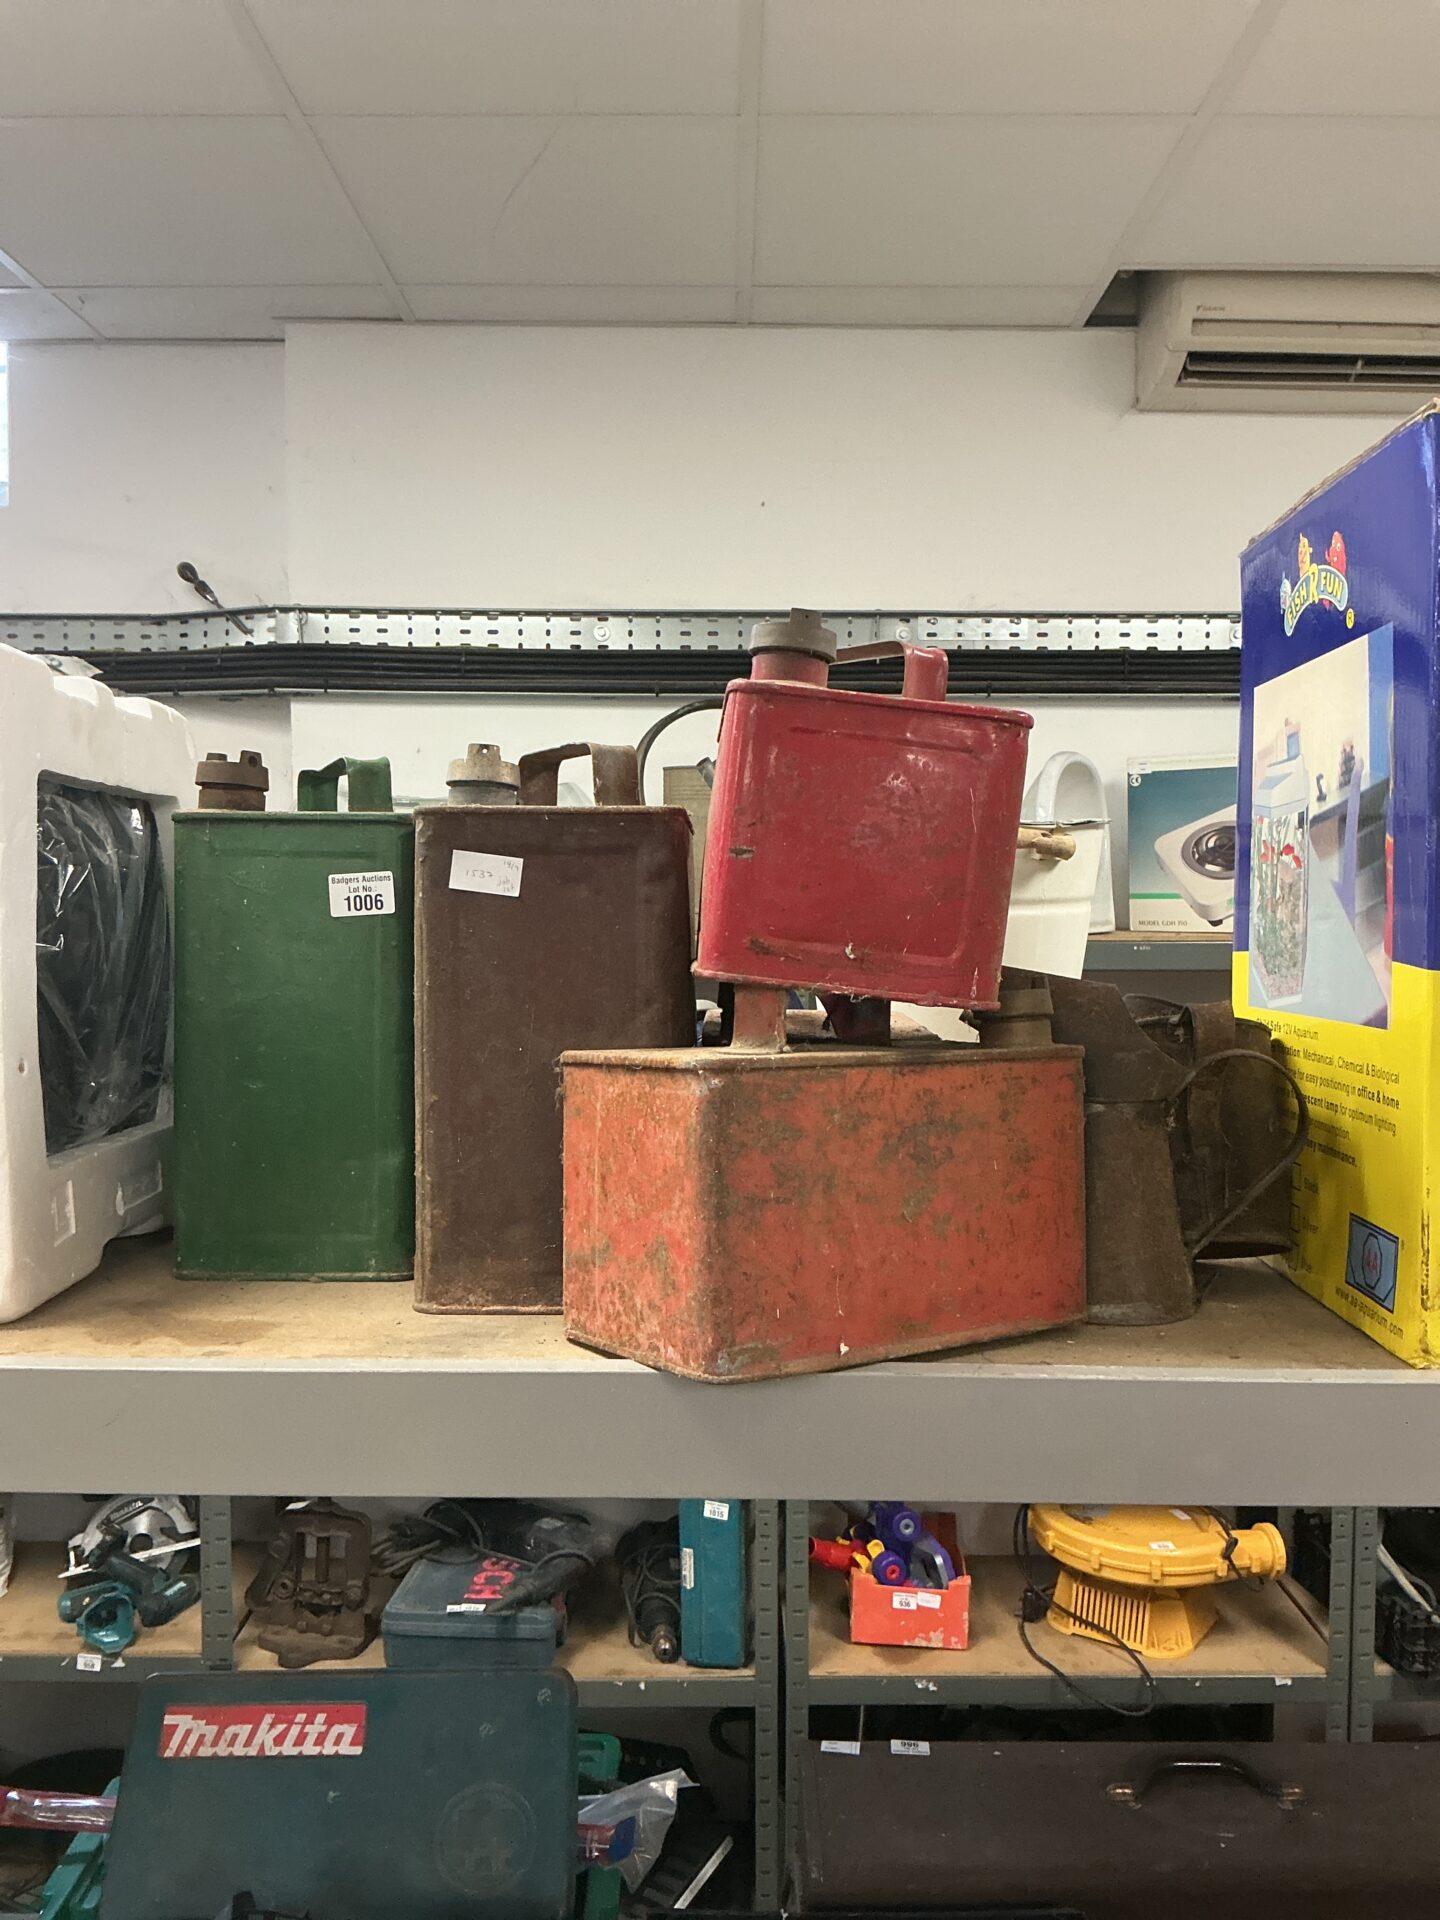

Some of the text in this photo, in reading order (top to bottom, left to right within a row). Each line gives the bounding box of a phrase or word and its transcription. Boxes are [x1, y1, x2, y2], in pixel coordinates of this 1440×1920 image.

[1286, 563, 1344, 626] FISH R FUN
[331, 874, 391, 885] Badgers Auctions
[344, 893, 384, 912] 1006
[1138, 919, 1159, 927] MODEL
[1270, 1020, 1282, 1033] Safe
[1337, 1055, 1365, 1075] Chemical
[1365, 1064, 1371, 1077] &
[1371, 1064, 1400, 1086] Biological
[1297, 1067, 1305, 1082] for
[1305, 1072, 1319, 1088] easy
[1319, 1075, 1350, 1097] positioning
[1350, 1084, 1356, 1096] in
[1357, 1085, 1375, 1102] office
[1376, 1089, 1382, 1104] &
[1324, 1097, 1339, 1114] lamp
[1339, 1100, 1348, 1115] for
[1348, 1105, 1374, 1126] optimum
[709, 1509, 724, 1519] 1015
